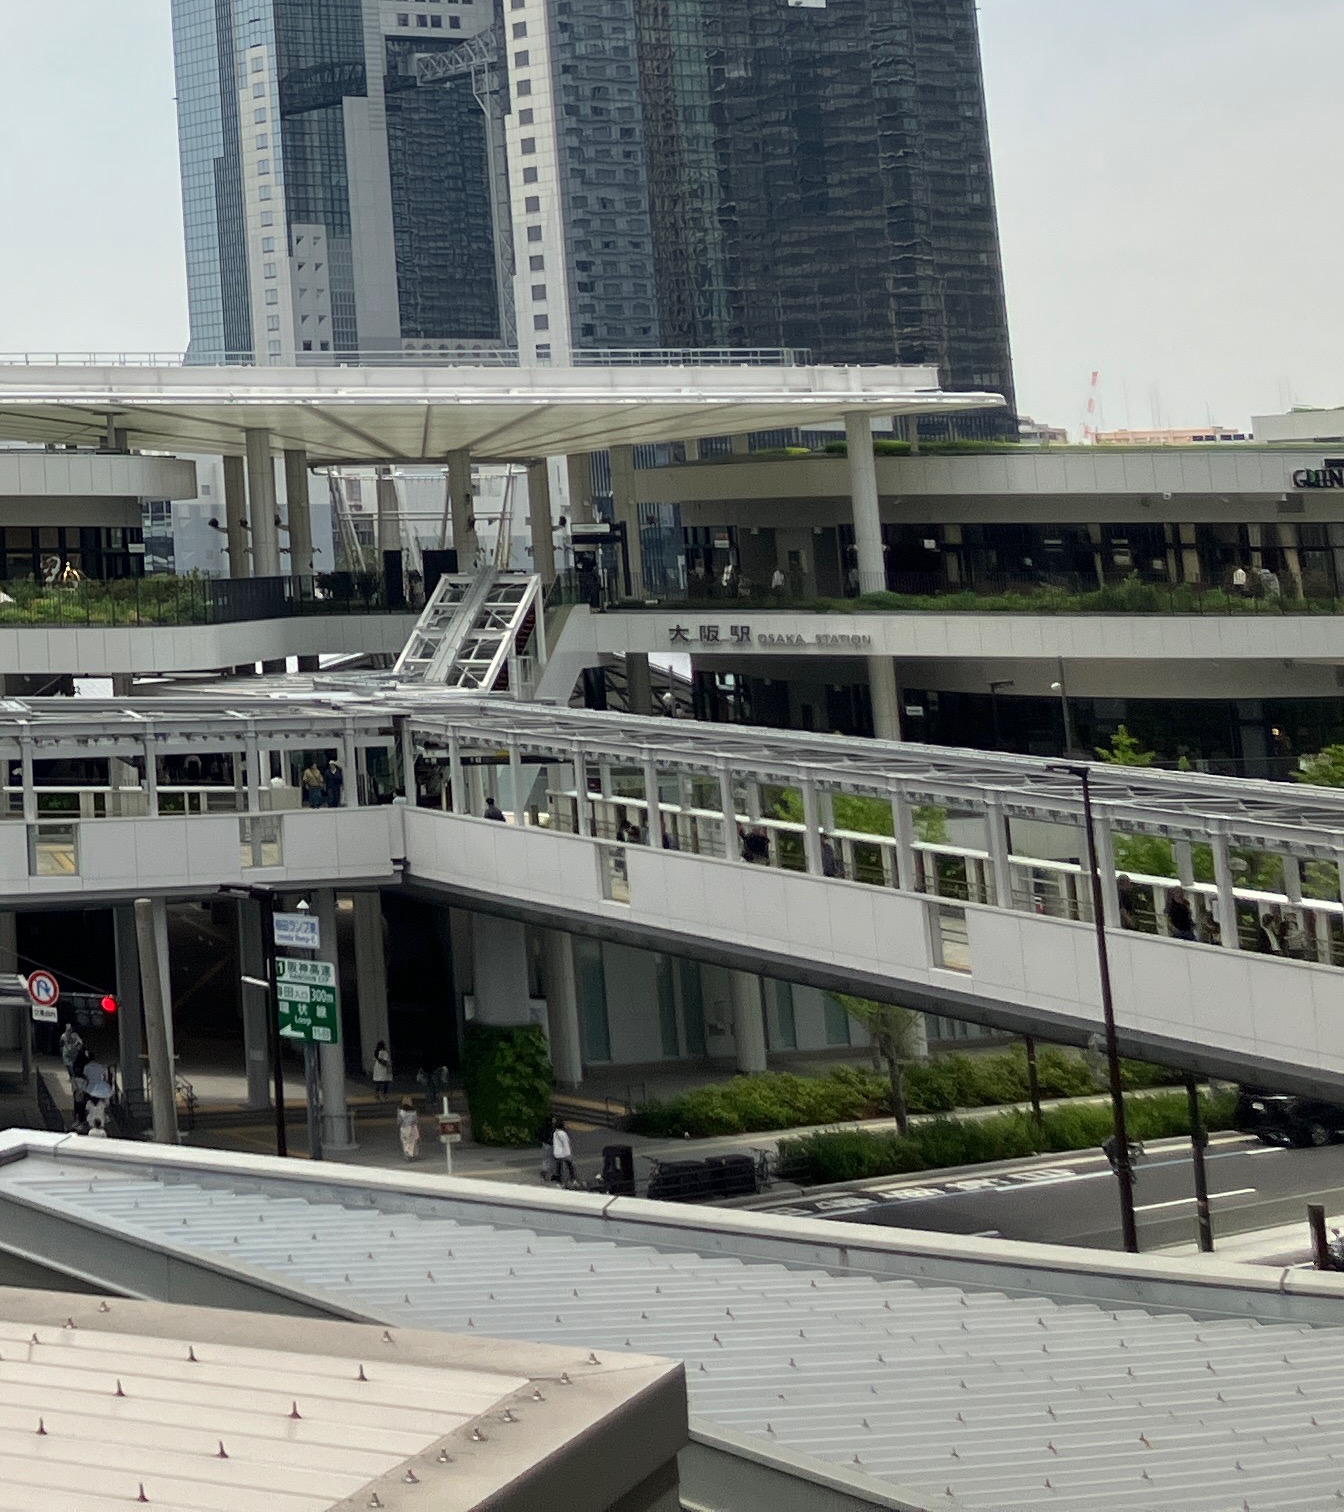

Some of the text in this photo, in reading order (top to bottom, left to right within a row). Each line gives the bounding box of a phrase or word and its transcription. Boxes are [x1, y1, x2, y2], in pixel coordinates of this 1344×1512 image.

[668, 624, 872, 645] 大阪駅 OSAKA STATION
